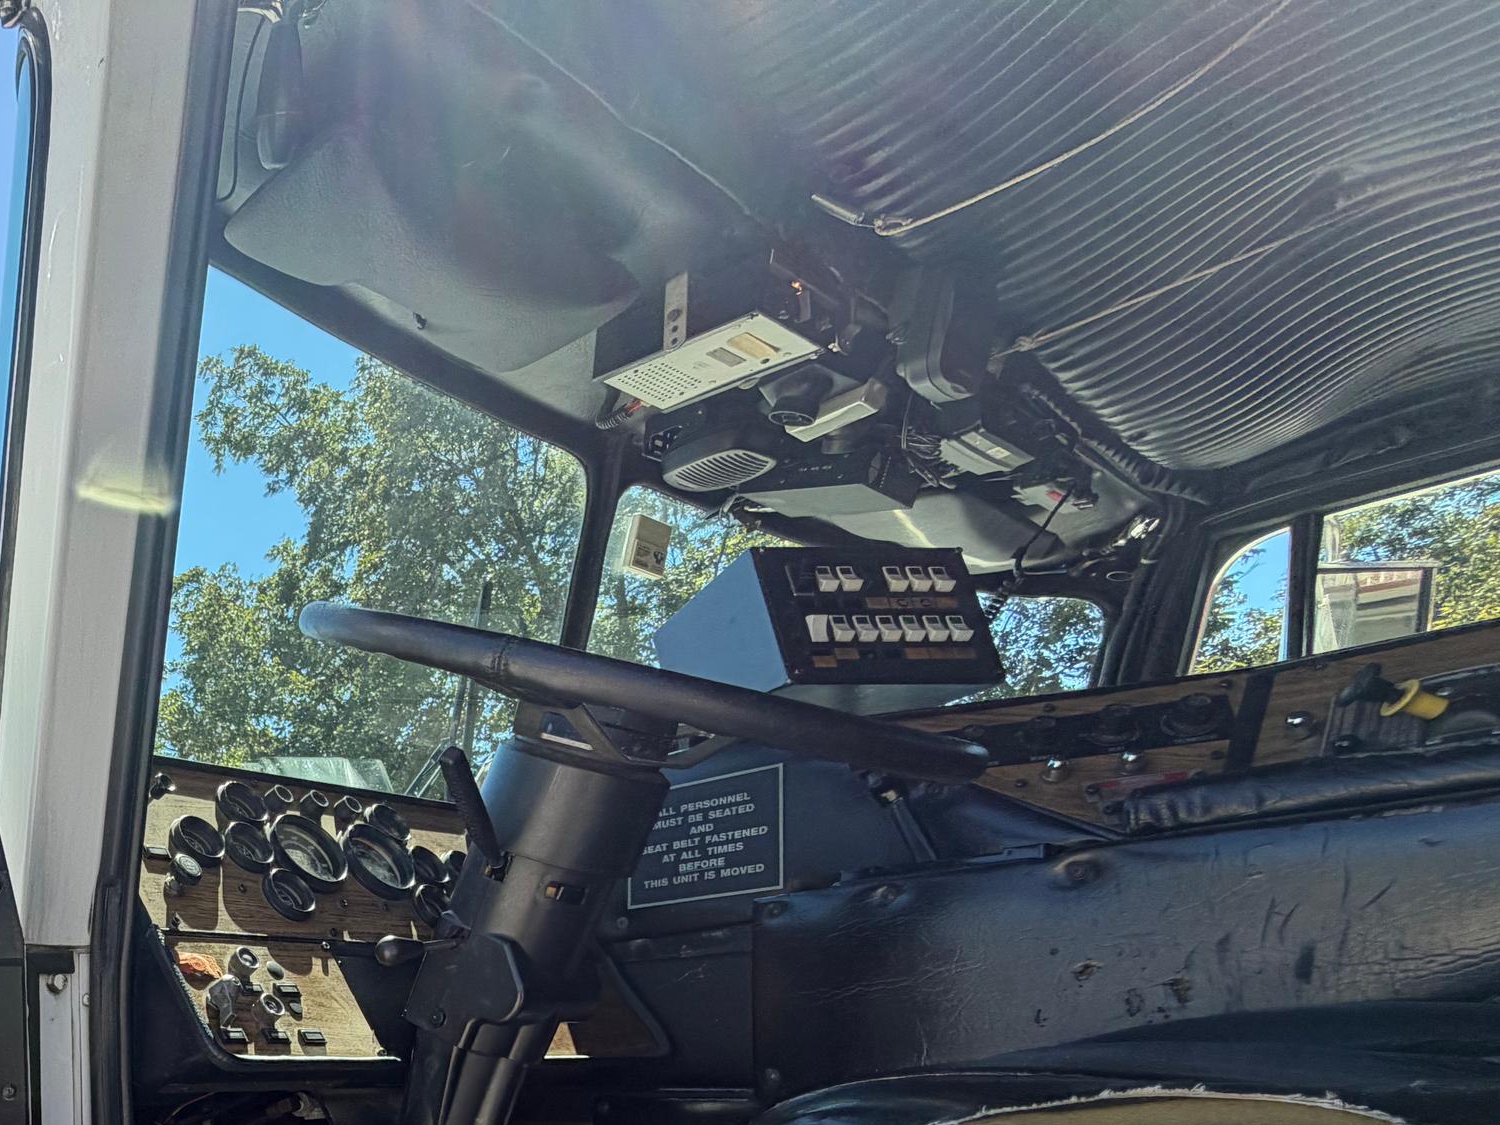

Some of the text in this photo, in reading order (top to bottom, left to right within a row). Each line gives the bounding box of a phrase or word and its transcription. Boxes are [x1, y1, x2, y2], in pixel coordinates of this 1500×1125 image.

[680, 792, 751, 813] PERSONNEL
[688, 813, 703, 823] BE
[708, 803, 755, 820] SEATED
[672, 837, 701, 850] BELT
[705, 825, 768, 844] FASTENED
[689, 823, 714, 835] AND
[662, 842, 744, 863] AT ALL TIMES
[678, 857, 726, 873] BEFORE
[643, 863, 765, 889] THIS UNIT IS MOVED
